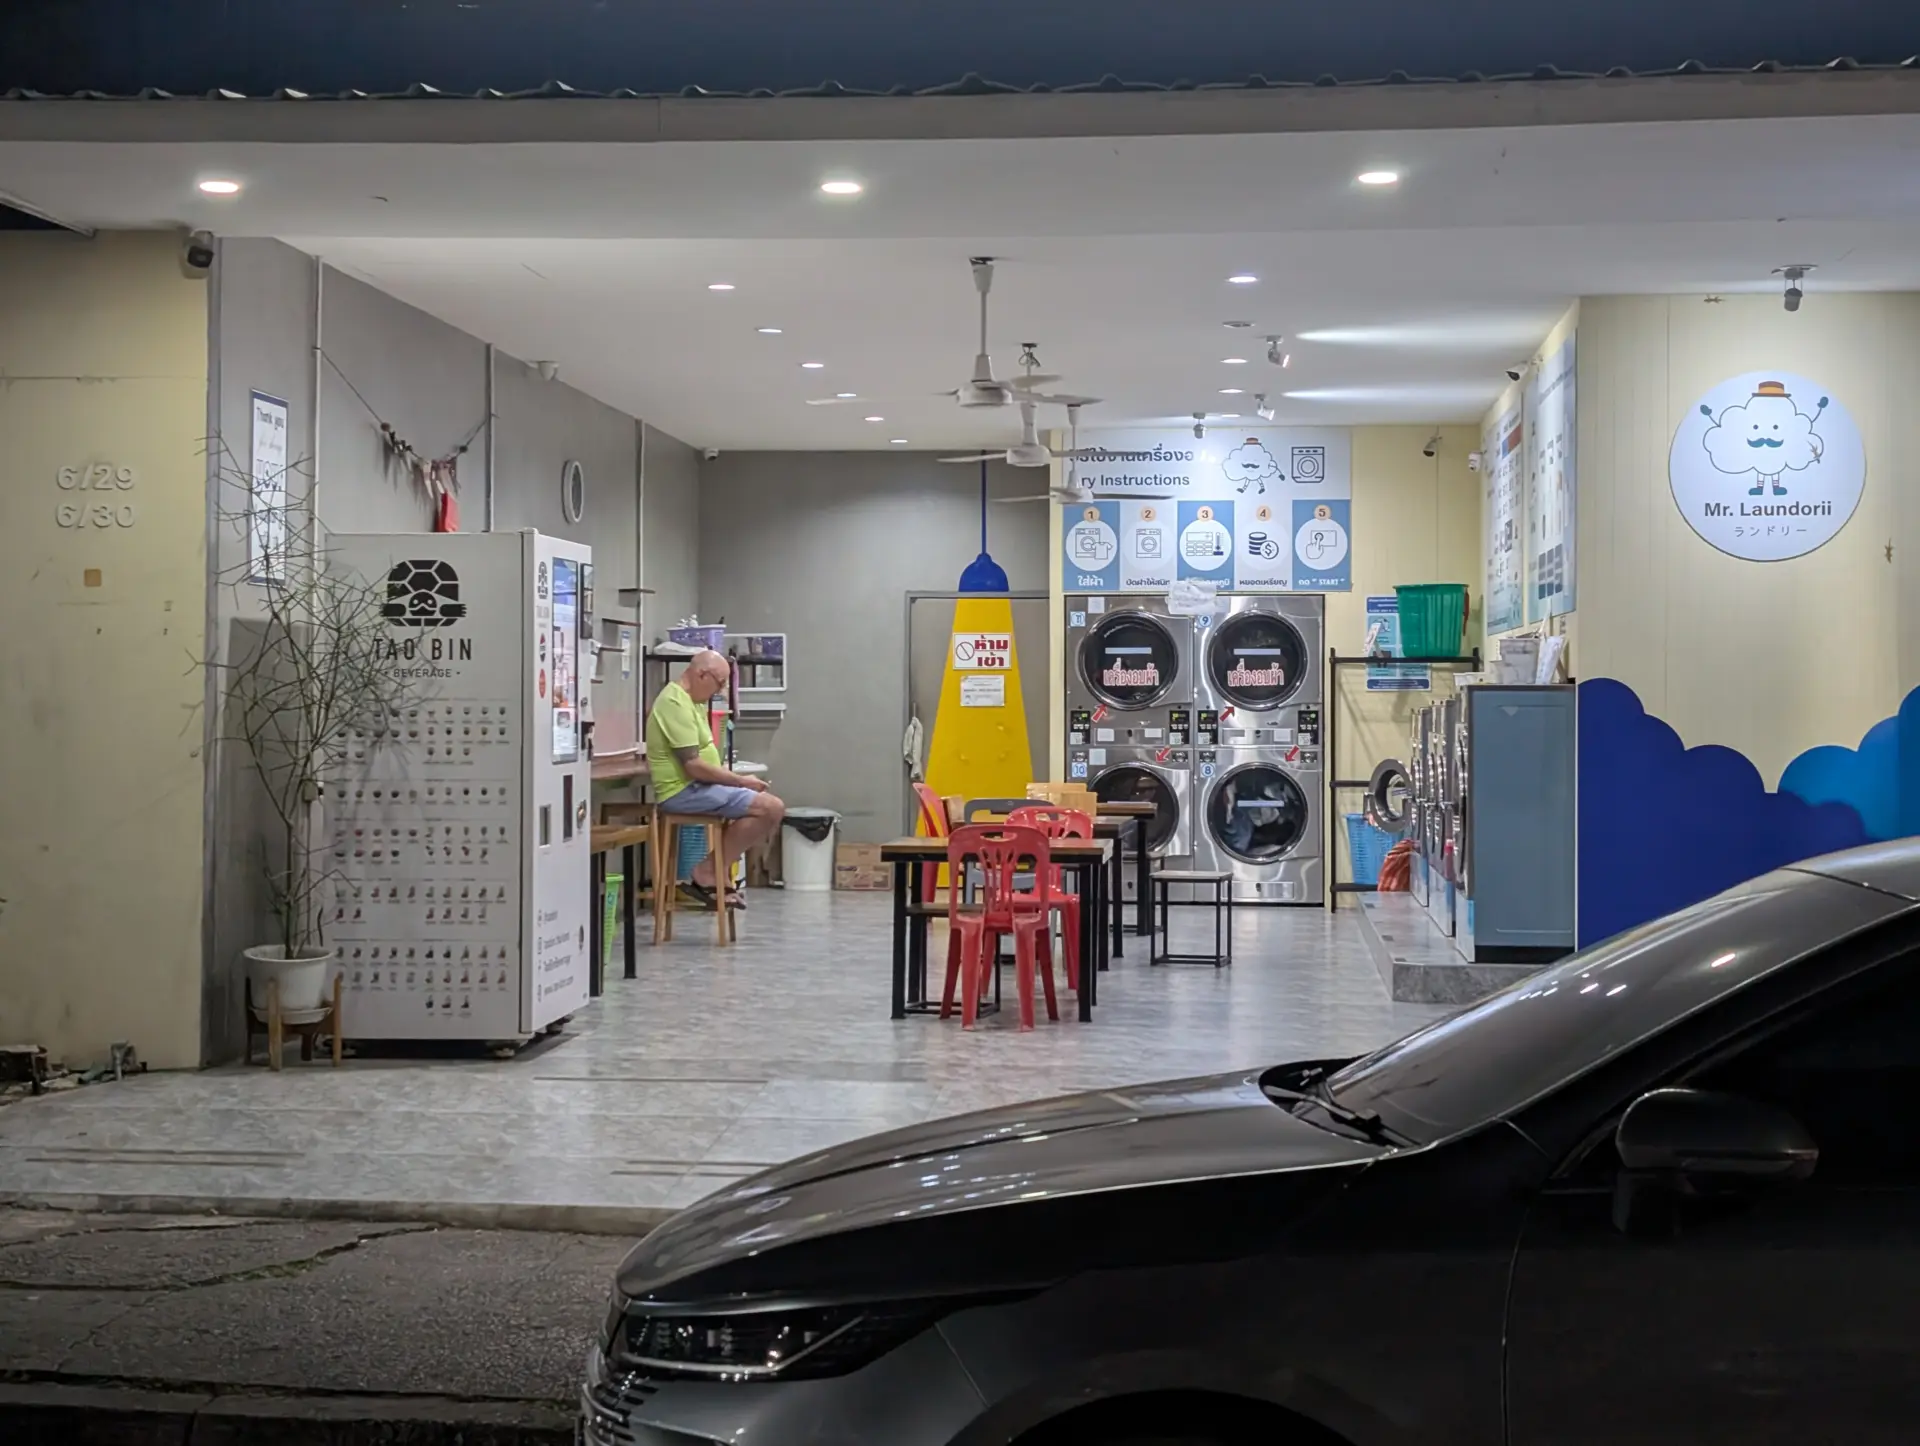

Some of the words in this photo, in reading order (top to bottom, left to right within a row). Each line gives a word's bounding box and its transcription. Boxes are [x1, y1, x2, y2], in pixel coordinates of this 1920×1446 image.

[56, 463, 135, 491] 6/29
[1080, 476, 1096, 489] ry
[1101, 474, 1190, 486] Instructions
[56, 501, 135, 529] 6/30
[1087, 510, 1095, 520] 1
[1144, 509, 1152, 519] 2
[1201, 509, 1209, 519] 3
[1259, 508, 1267, 518] 4
[1318, 508, 1326, 518] 5
[1704, 502, 1734, 517] Mr.
[1740, 501, 1832, 516] Laundorii
[1734, 525, 1807, 538] ランドリー
[374, 638, 415, 660] TAO
[432, 638, 471, 660] BIN
[974, 634, 1008, 650] ห้าม
[977, 652, 1004, 667] เข้า
[393, 668, 452, 678] BEVERAGE
[1103, 657, 1160, 687] เครื่องอบผ้า
[1227, 658, 1285, 687] เครื่องอบผ้า
[1075, 765, 1085, 775] 10
